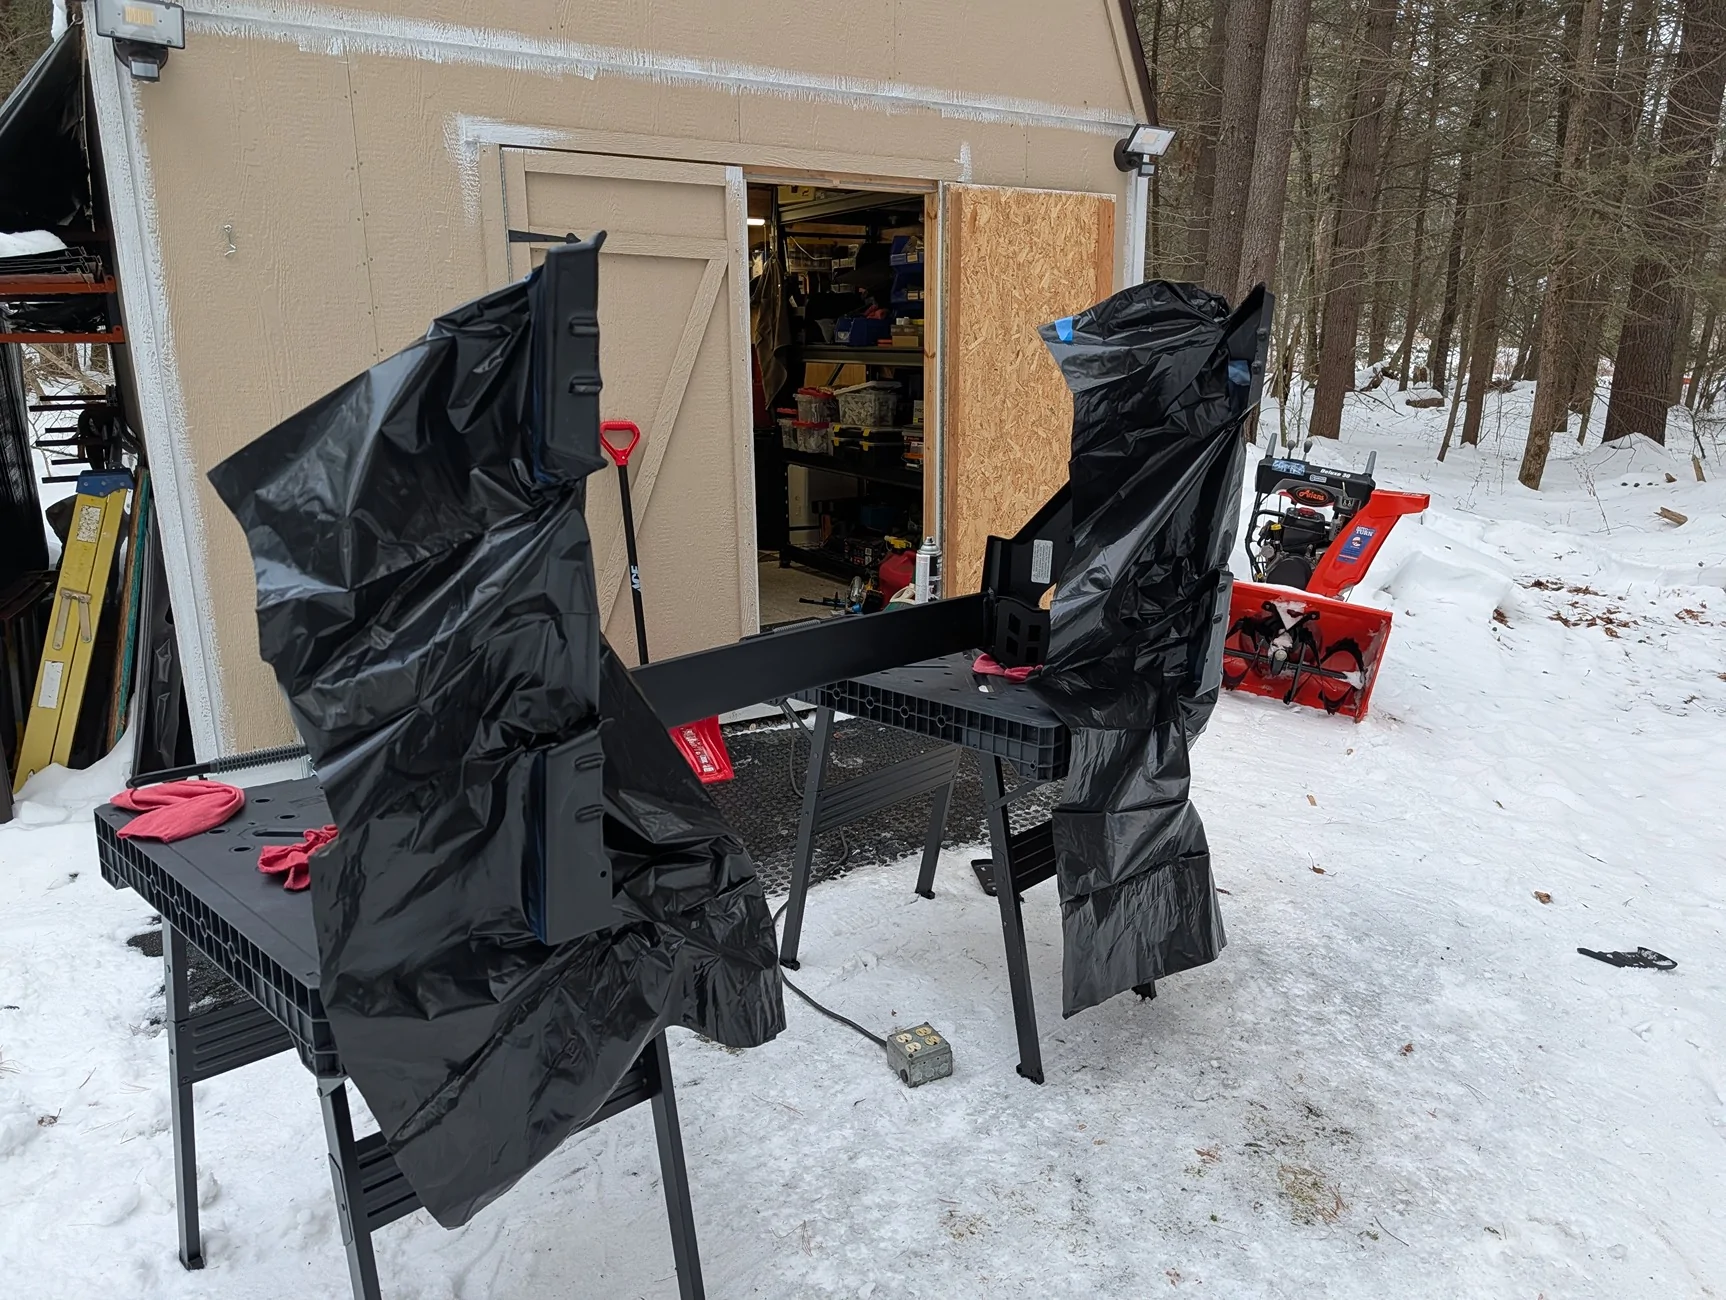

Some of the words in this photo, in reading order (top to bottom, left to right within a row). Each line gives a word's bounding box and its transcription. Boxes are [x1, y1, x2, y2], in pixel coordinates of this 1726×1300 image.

[1320, 468, 1342, 477] Deluxe
[1298, 489, 1325, 501] Ariens
[1356, 529, 1374, 537] TURN
[630, 565, 641, 592] ACE
